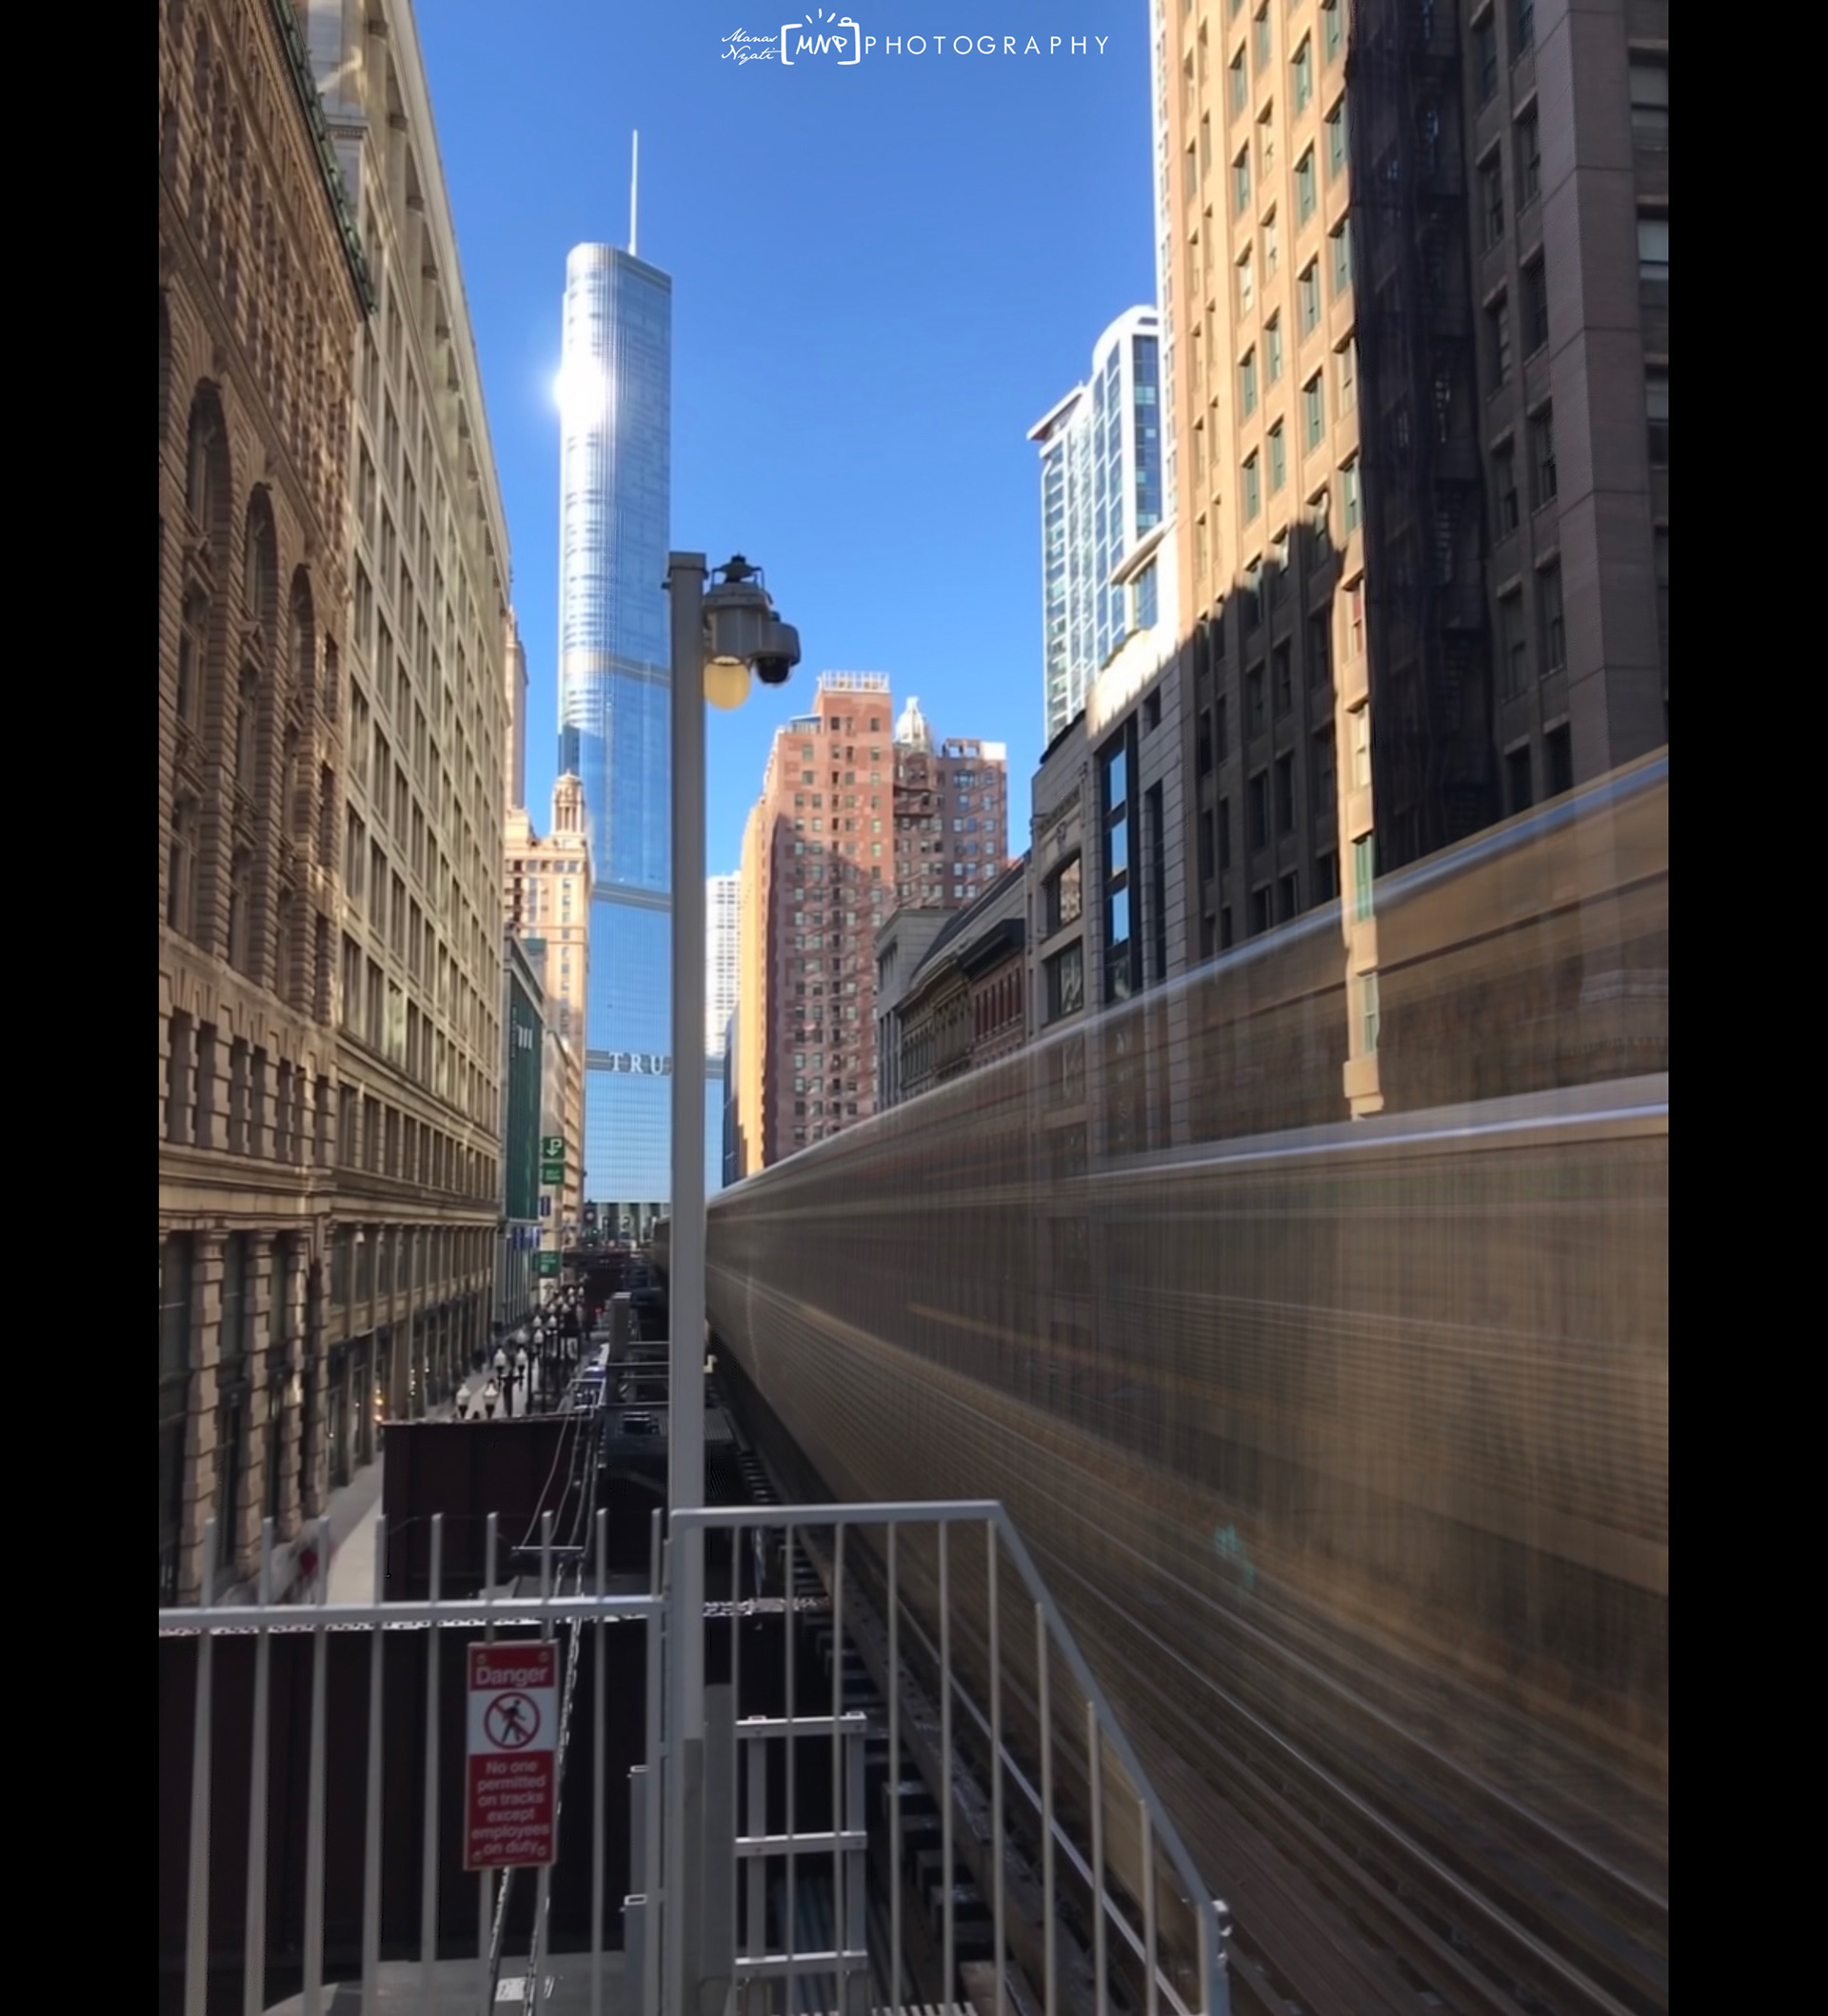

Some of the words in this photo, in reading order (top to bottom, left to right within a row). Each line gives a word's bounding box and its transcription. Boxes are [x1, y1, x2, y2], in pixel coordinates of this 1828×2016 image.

[475, 1666, 549, 1688] Danger
[487, 1761, 507, 1774] No
[509, 1760, 538, 1773] one
[477, 1774, 547, 1793] permitted
[477, 1793, 498, 1807] on
[499, 1790, 546, 1806] tracks
[487, 1806, 536, 1824] except
[470, 1823, 551, 1841] employees
[483, 1842, 504, 1856] on
[505, 1839, 539, 1856] duty
